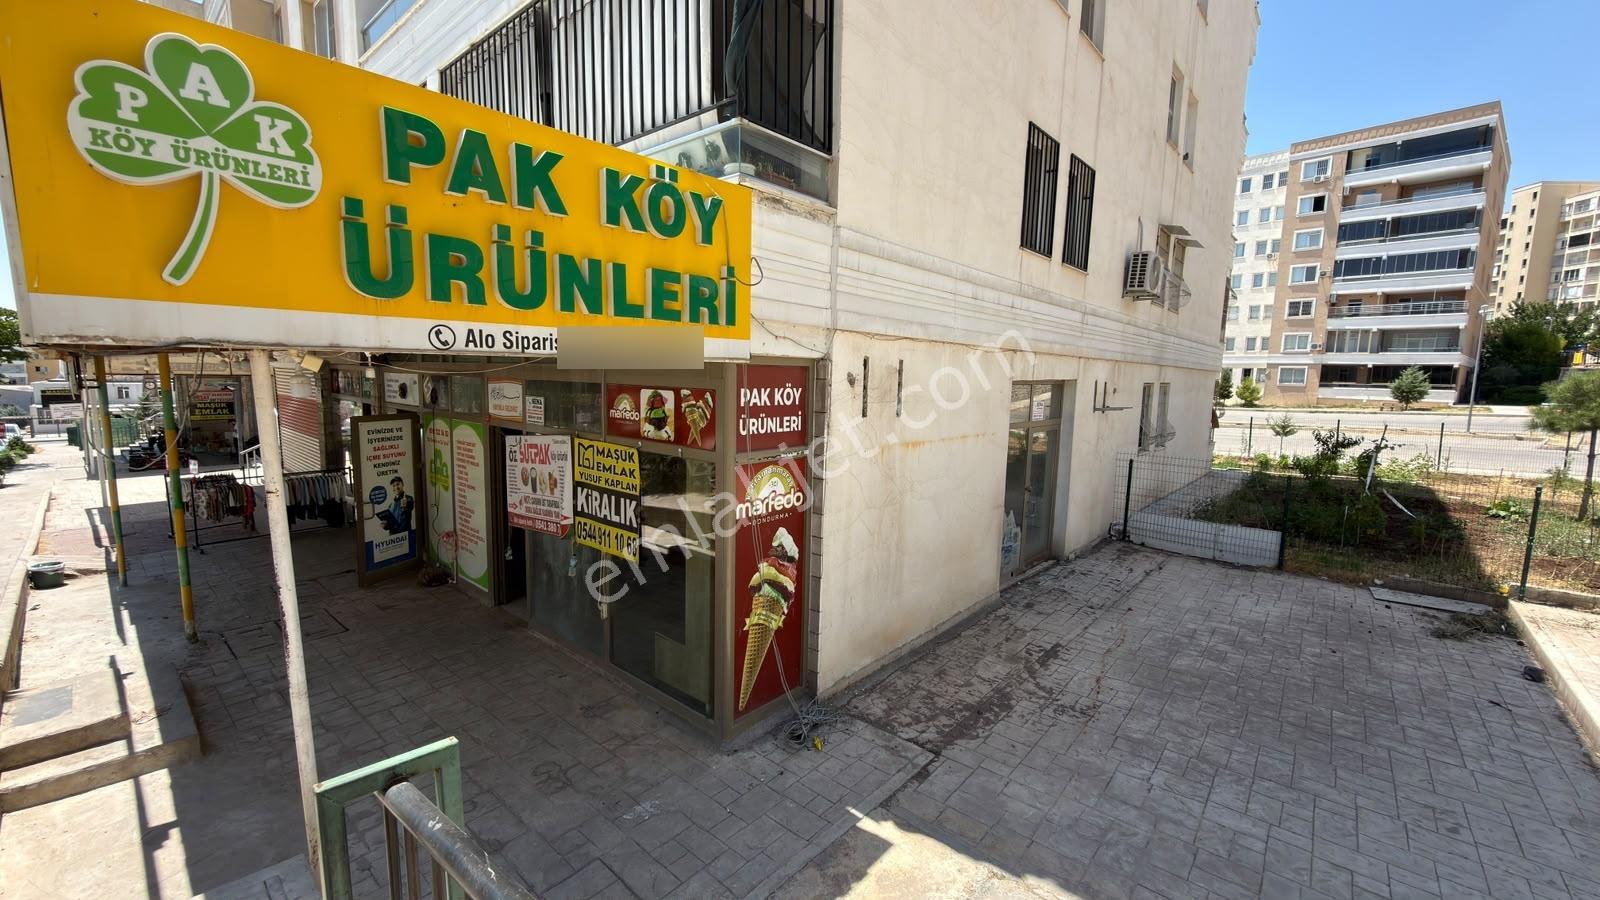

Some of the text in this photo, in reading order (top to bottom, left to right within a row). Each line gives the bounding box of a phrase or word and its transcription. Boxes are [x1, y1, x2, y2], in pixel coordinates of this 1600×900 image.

[88, 125, 311, 188] KÖY ÜRÜNLERİ
[380, 104, 724, 247] PAK KÖY
[339, 195, 737, 327] ÜRÜNLERİ
[464, 328, 496, 349] Alo
[740, 383, 802, 407] PAK KÖY
[609, 405, 640, 421] marfedo
[739, 411, 802, 436] ÜRÜNLERİ
[596, 446, 636, 464] MAŞUK
[596, 461, 637, 479] EMLAK
[579, 471, 638, 492] YUSUF KAPLAN
[736, 487, 803, 520] marfedo
[375, 534, 407, 550] HYUNDAI
